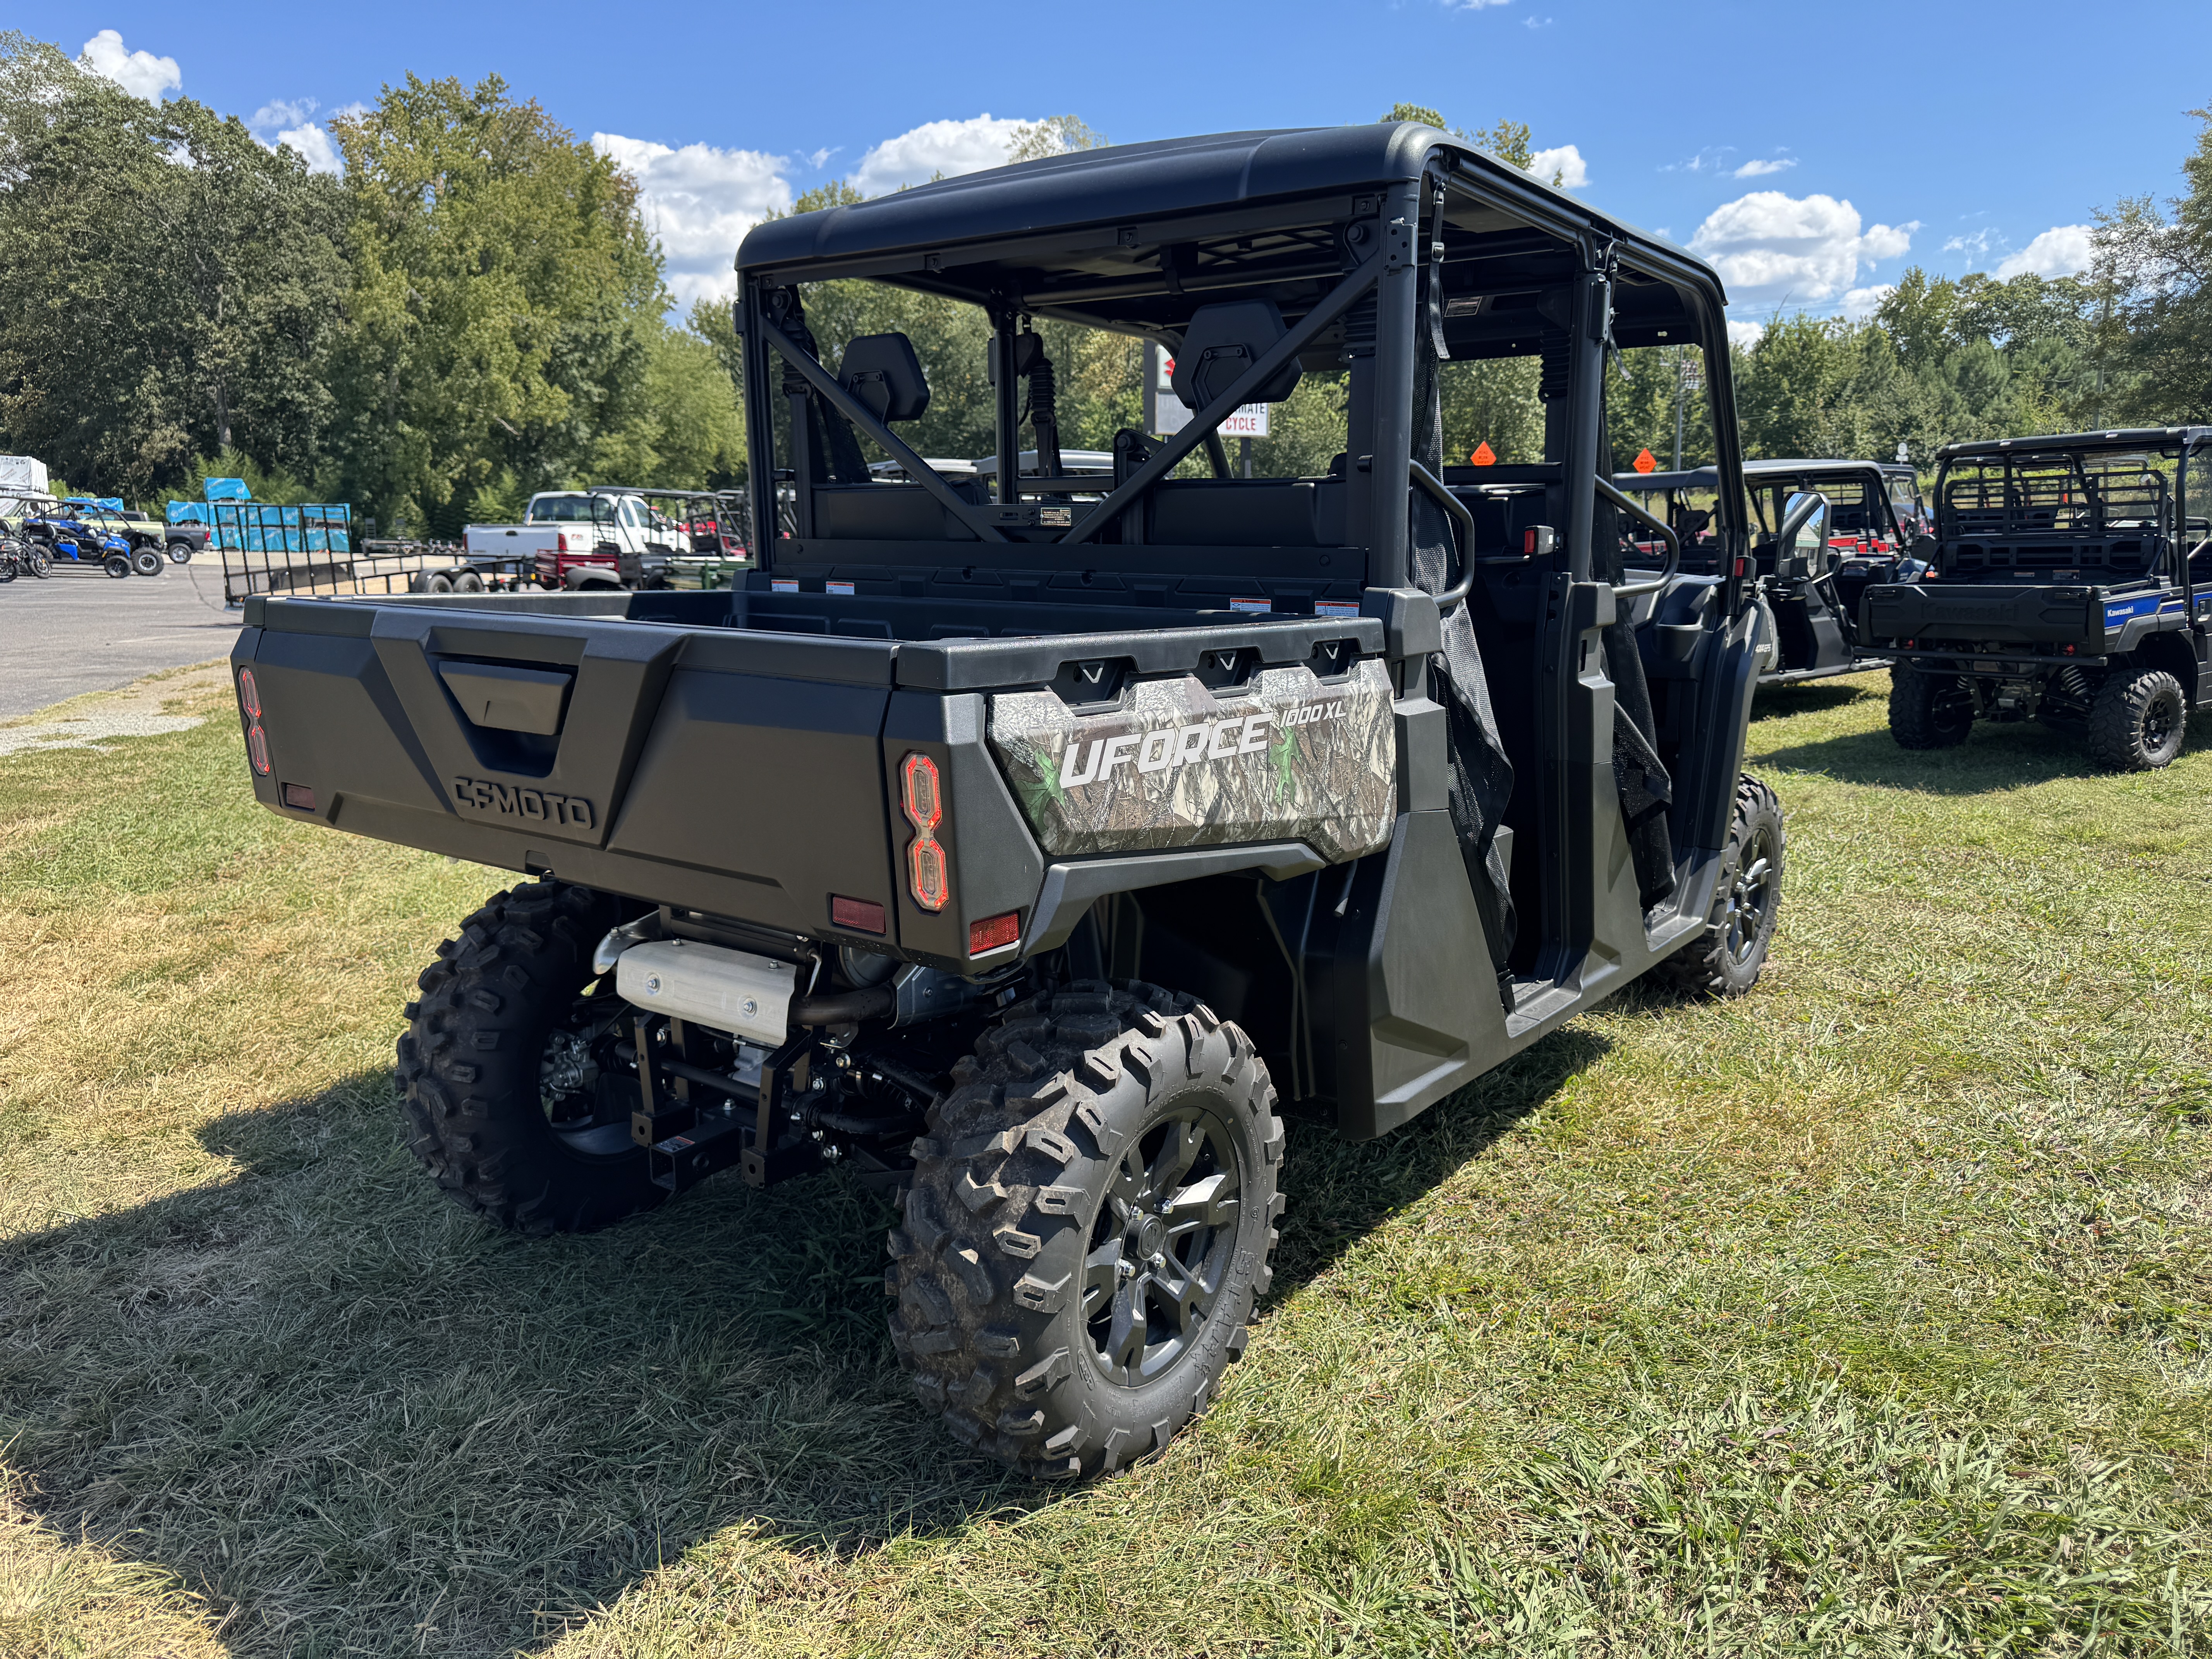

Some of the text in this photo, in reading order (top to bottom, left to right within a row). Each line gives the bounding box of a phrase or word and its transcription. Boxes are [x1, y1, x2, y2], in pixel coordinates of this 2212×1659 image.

[1226, 417, 1256, 431] CYCLE
[2107, 606, 2133, 617] Kawasaki
[1059, 701, 1347, 788] UFORCE 1000 XL
[451, 776, 593, 830] CFMOTO
